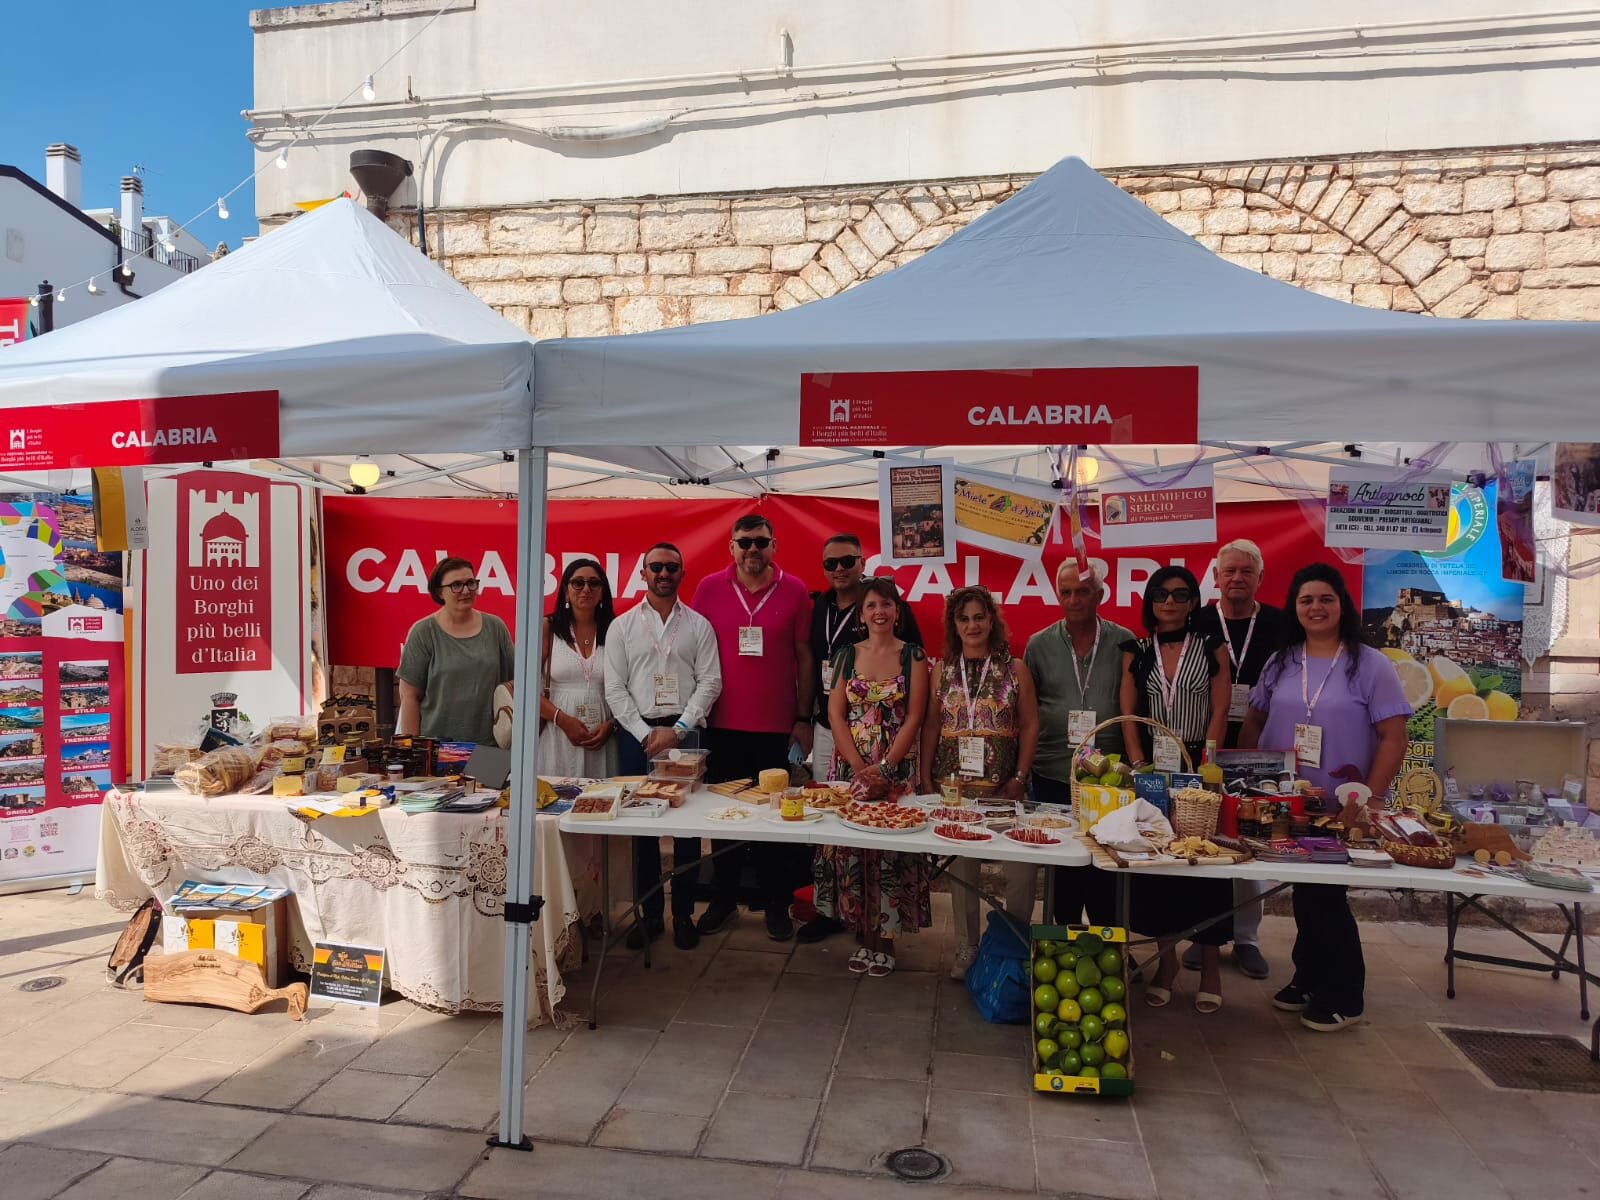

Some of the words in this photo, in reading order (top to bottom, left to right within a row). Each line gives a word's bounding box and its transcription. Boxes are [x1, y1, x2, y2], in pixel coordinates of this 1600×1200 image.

[967, 404, 1113, 426] CALABRIA
[110, 426, 217, 449] CALABRIA
[958, 488, 988, 504] Miele
[1129, 490, 1207, 503] SALUMIFICIO
[1129, 502, 1174, 513] SERGIO
[346, 547, 649, 599] CAAIA
[863, 553, 1222, 608] ALARA
[190, 575, 226, 592] Uno
[231, 575, 259, 592] dei
[193, 599, 254, 617] Borghi
[187, 622, 216, 642] più
[223, 622, 261, 639] belli
[191, 647, 257, 664] d'Italia
[64, 735, 108, 743] TREBISACCE
[71, 792, 100, 800] TROPEA
